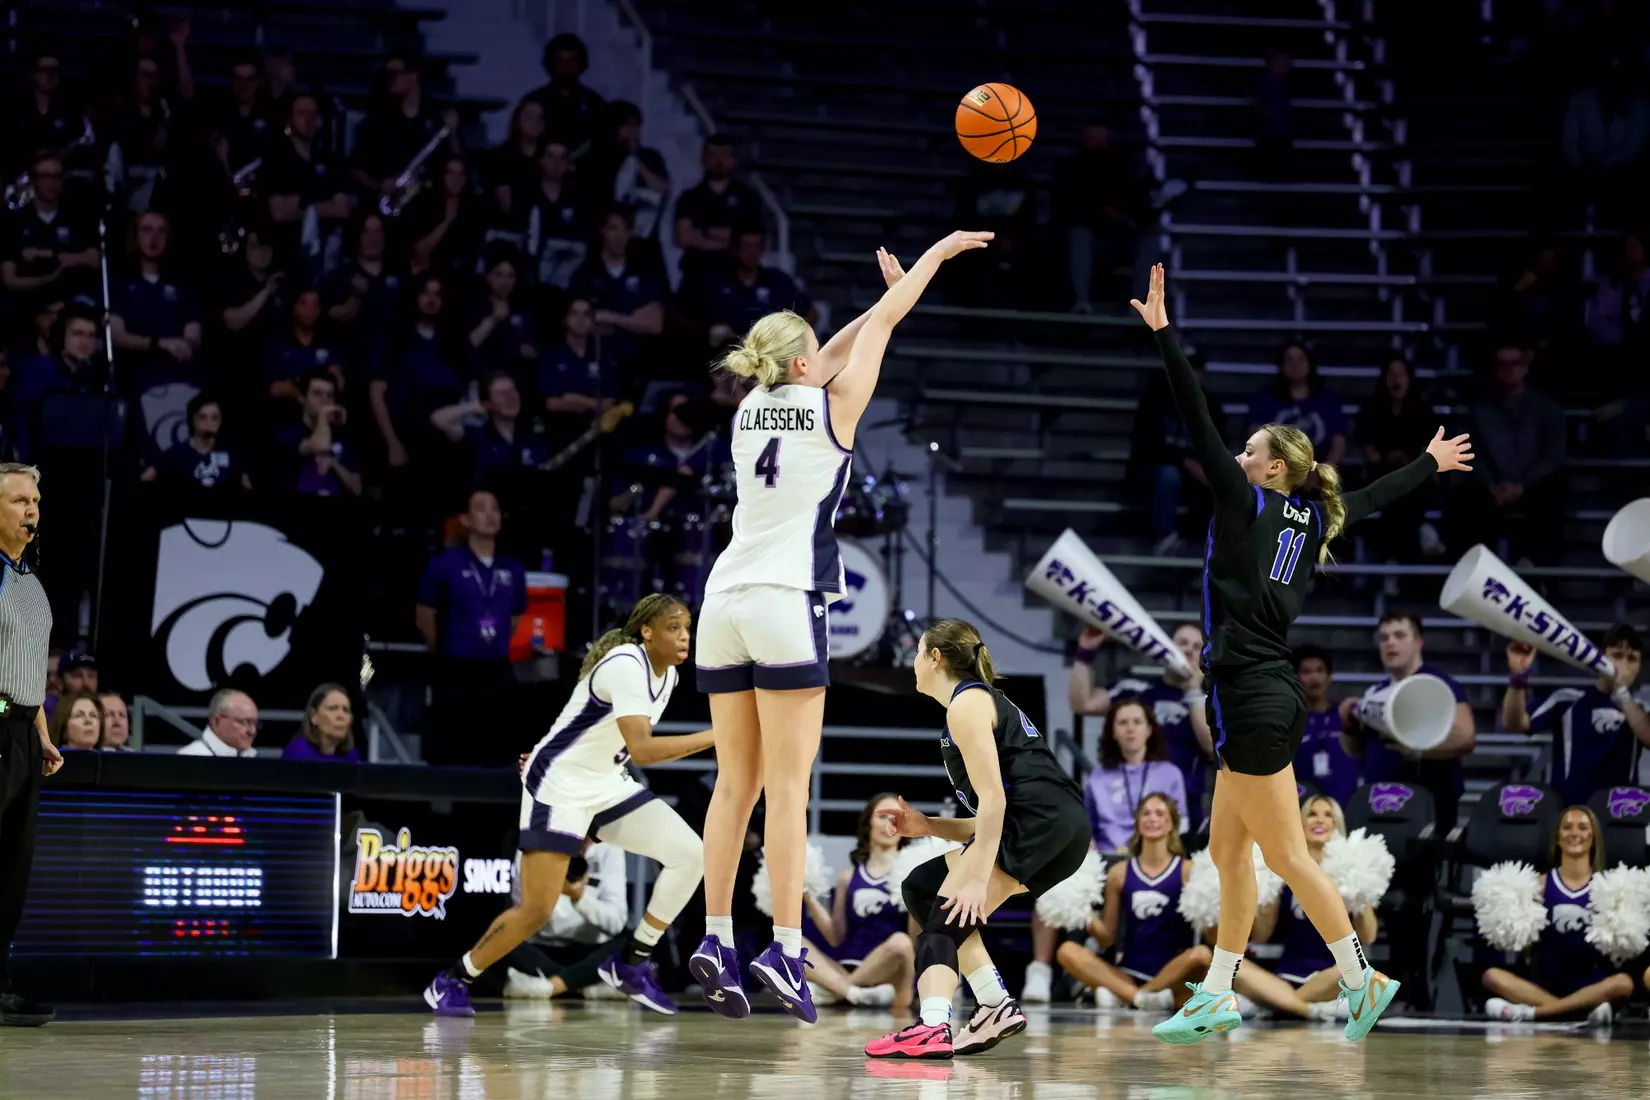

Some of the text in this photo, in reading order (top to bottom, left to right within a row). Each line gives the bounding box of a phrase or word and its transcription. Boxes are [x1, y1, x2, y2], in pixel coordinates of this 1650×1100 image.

[740, 408, 814, 431] CLAESSENS
[754, 436, 782, 488] 4
[1269, 527, 1307, 585] 11
[1066, 580, 1176, 661] K-STATE
[1504, 594, 1608, 670] K-STATE
[350, 828, 511, 913] Briggs SINCE
